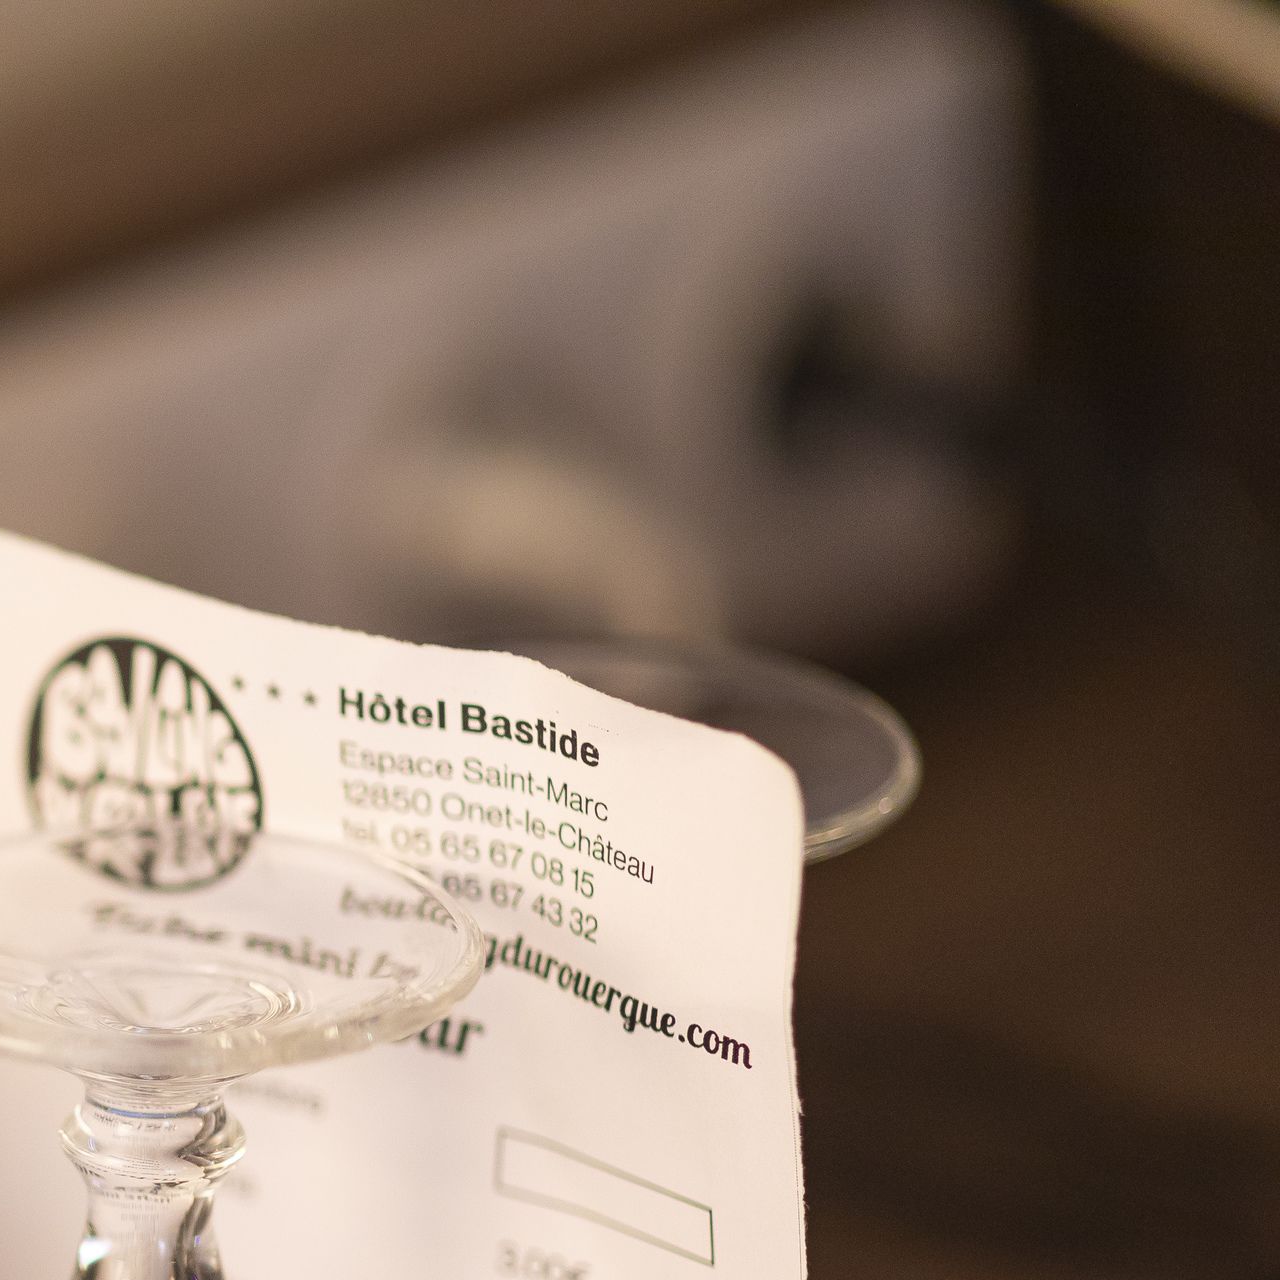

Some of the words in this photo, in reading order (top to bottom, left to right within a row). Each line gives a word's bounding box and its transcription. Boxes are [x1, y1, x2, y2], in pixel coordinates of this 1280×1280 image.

[338, 686, 447, 731] Hôtel
[461, 703, 602, 768] Bastide
[339, 740, 454, 781] Espace
[462, 757, 610, 824] Saint-Marc
[341, 779, 433, 816] 12850
[439, 791, 656, 885] Onet-le-Château
[390, 823, 433, 857] 05
[440, 828, 481, 863] 65
[489, 833, 524, 872] 67
[530, 844, 565, 888] 08
[573, 868, 596, 900] 15
[490, 874, 525, 913] 67
[532, 894, 563, 928] 43
[569, 909, 599, 945] 32
